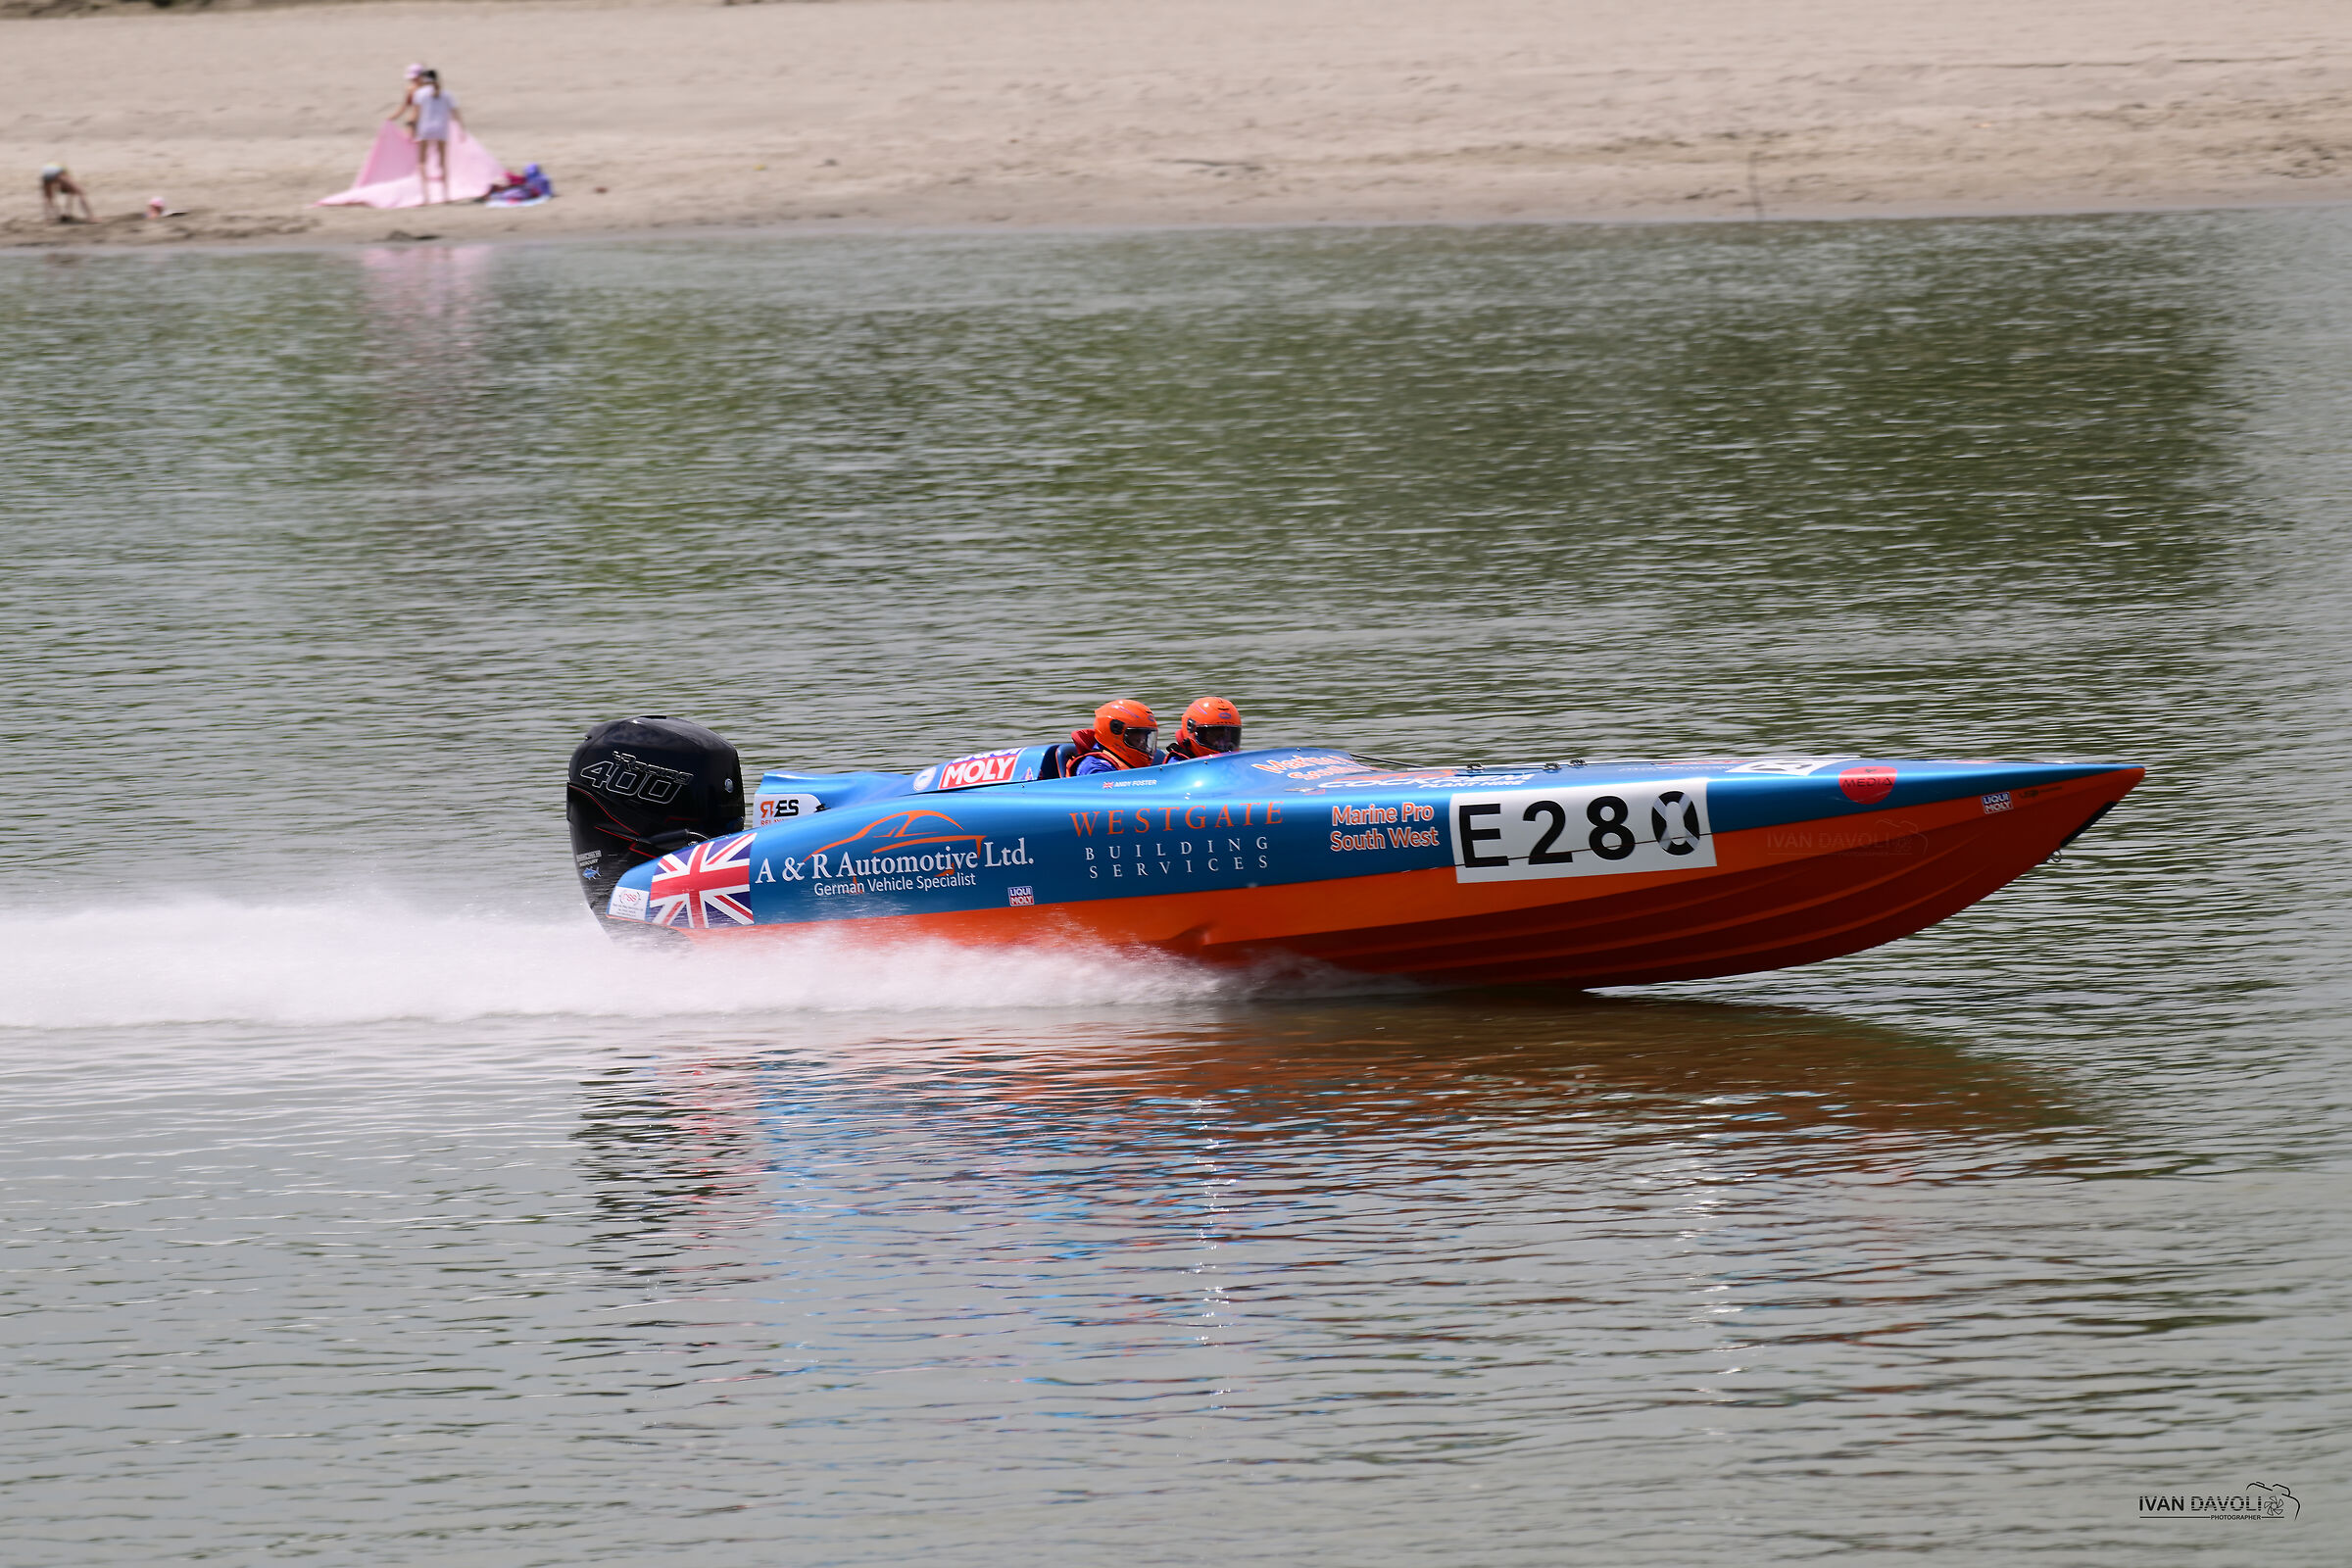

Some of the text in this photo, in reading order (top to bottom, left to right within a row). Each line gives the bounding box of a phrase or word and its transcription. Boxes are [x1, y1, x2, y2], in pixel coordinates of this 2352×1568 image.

[580, 760, 683, 804] 400
[942, 757, 1016, 788] MOLY
[1842, 777, 1893, 787] MEDIA
[1983, 794, 2010, 805] LIQUI
[1984, 802, 2011, 812] MOLY
[1069, 801, 1284, 837] WESTGATE
[1332, 802, 1434, 826] Marine Pro
[1330, 827, 1440, 852] South West
[1459, 791, 1700, 868] E280
[756, 837, 1034, 883] A & R Automotive Ltd.
[1085, 837, 1268, 860] BUILDING
[1090, 856, 1268, 879] SERVICES
[814, 871, 976, 897] German Vehicle Specialist
[1009, 887, 1033, 897] LIQUI
[1010, 895, 1033, 906] MOLY
